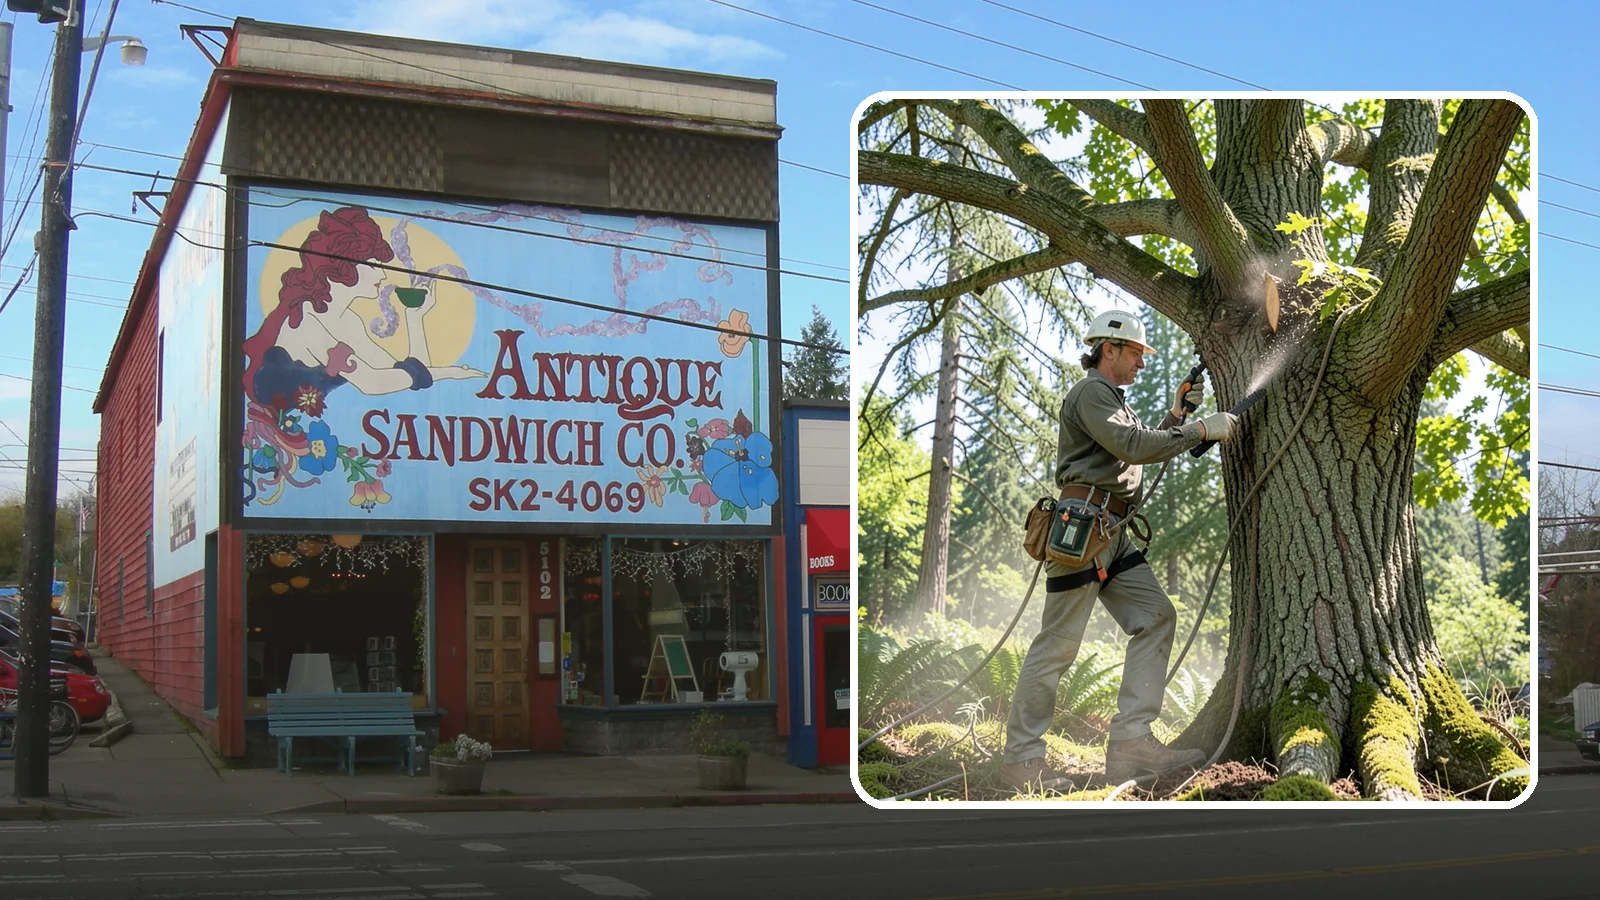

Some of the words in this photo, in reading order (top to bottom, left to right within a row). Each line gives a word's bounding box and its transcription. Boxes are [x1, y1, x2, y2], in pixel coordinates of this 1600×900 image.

[475, 329, 724, 421] ANTIQUE
[361, 409, 604, 467] SANDWICH
[617, 421, 685, 468] CO.
[469, 477, 646, 513] SK2-4069
[540, 541, 551, 600] 5102
[809, 555, 835, 569] BOOKS
